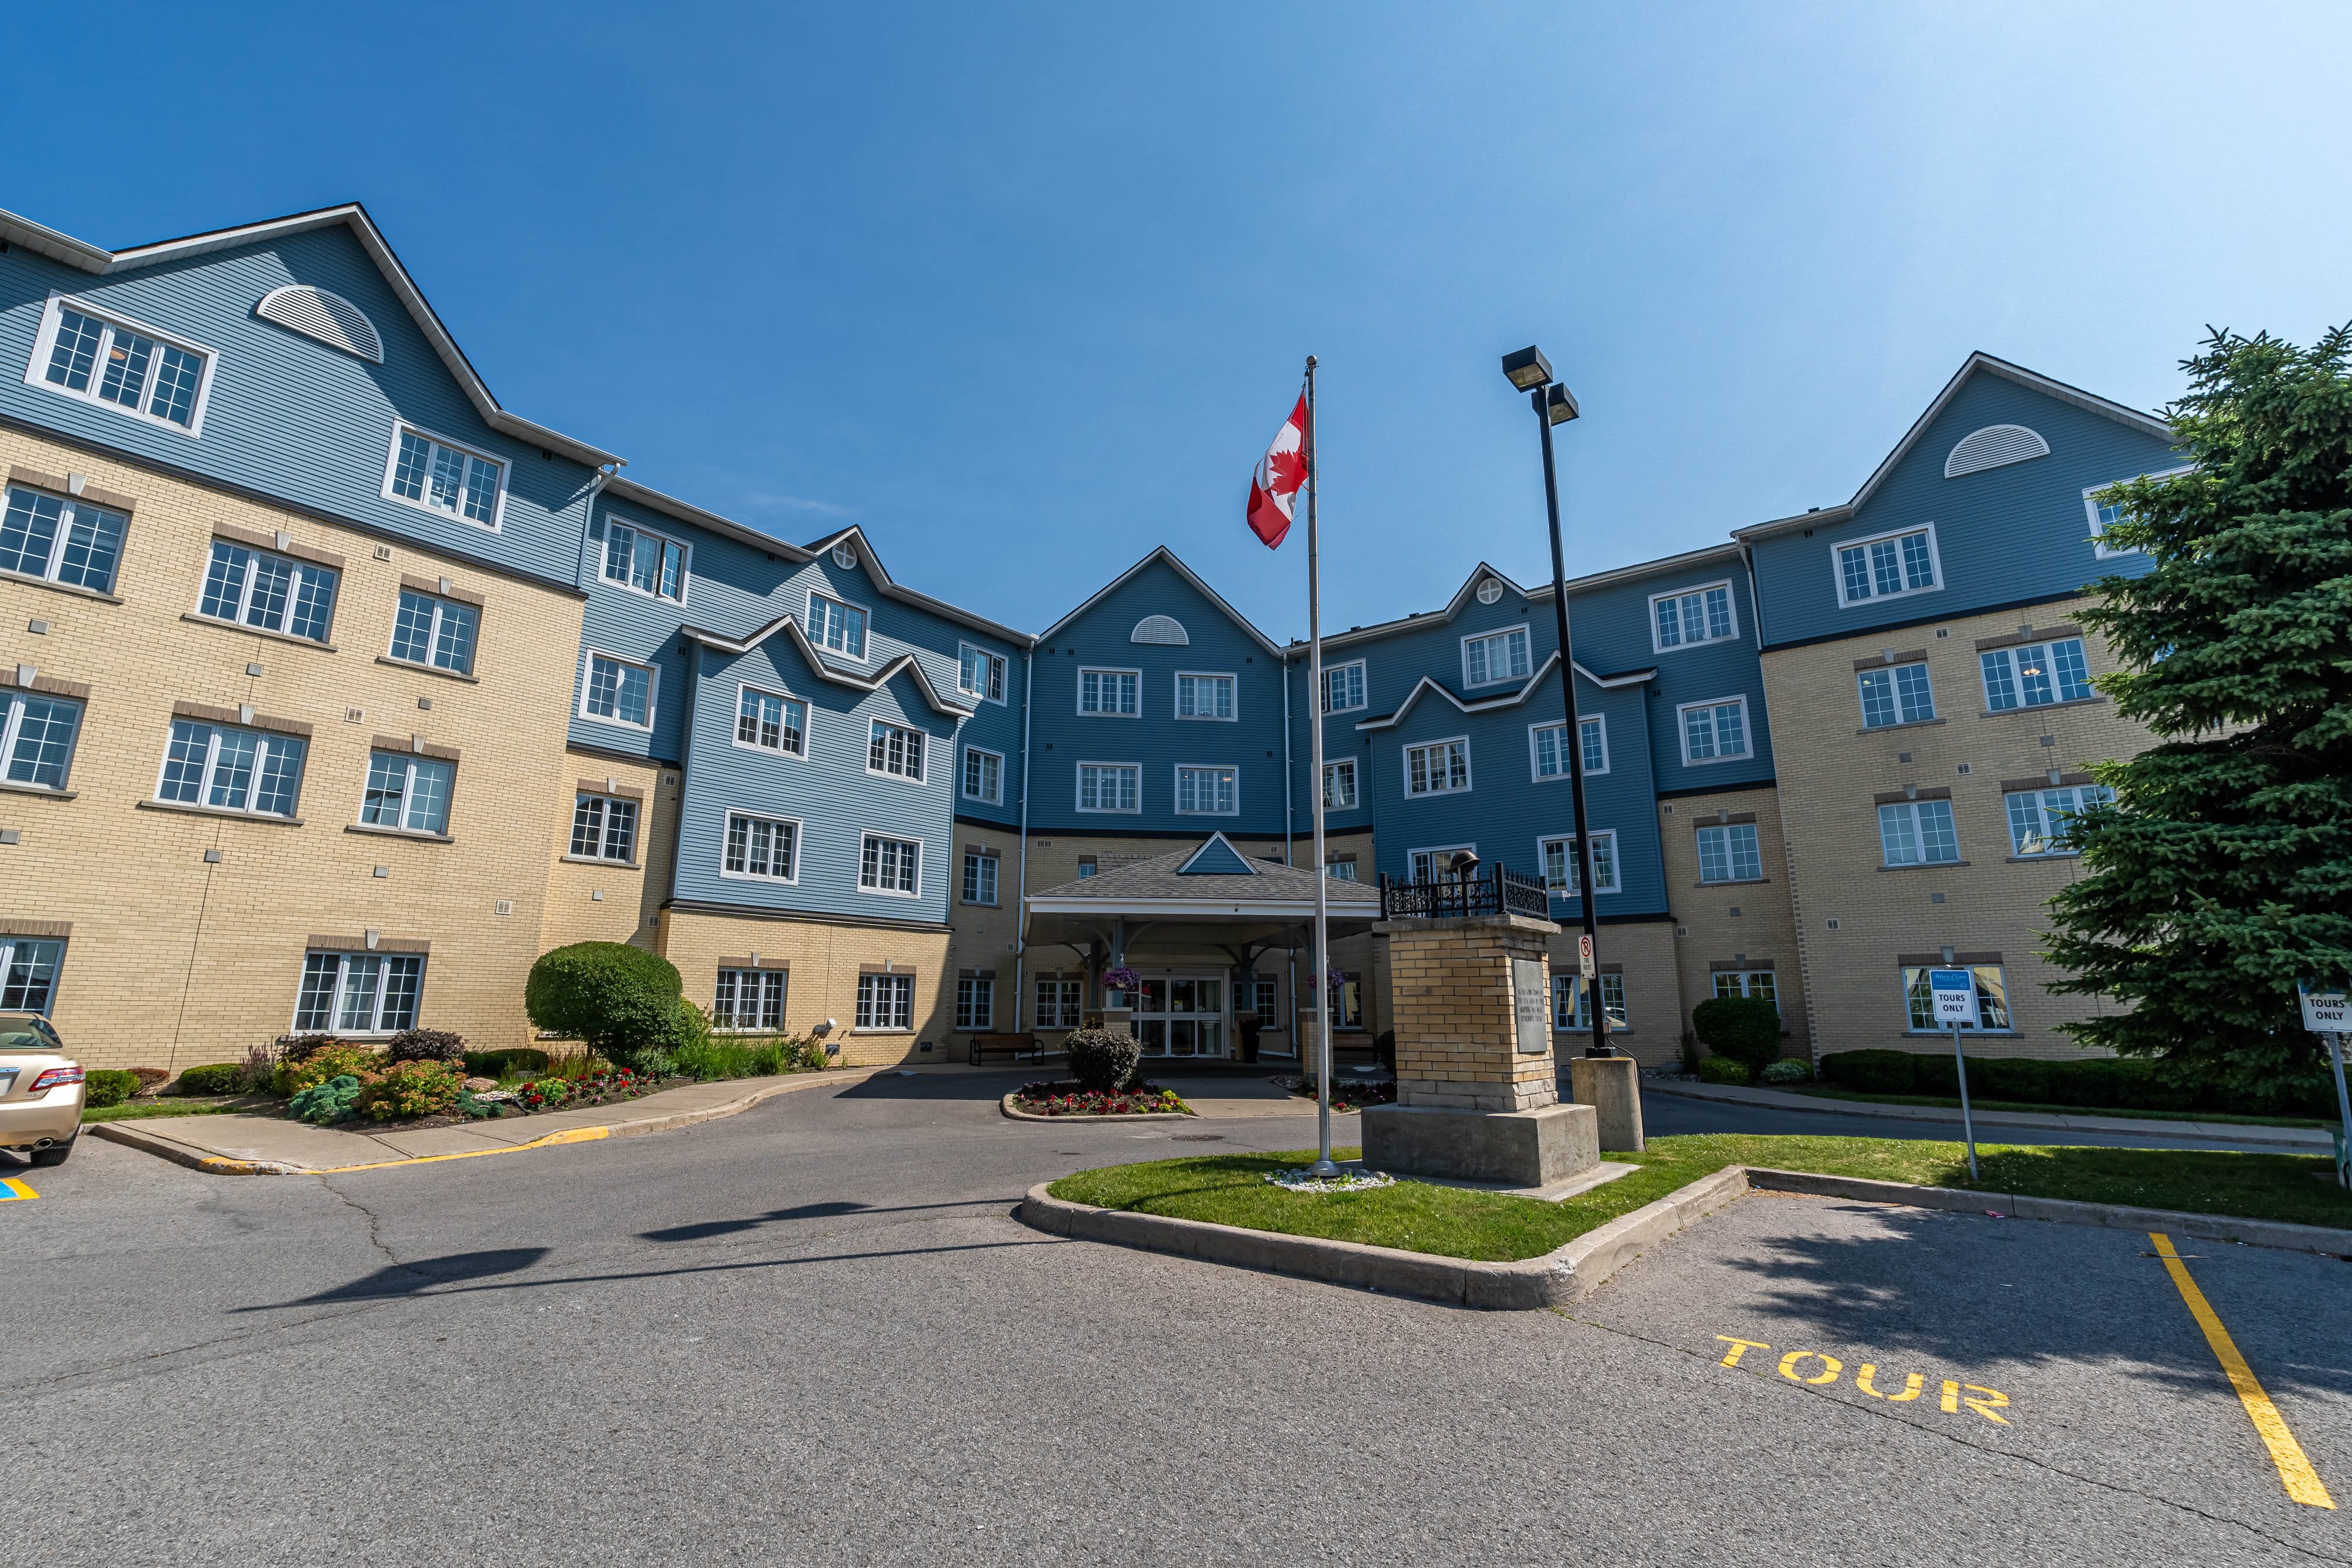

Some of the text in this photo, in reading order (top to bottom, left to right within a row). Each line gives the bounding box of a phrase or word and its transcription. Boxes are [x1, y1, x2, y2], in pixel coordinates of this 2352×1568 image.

[2310, 999, 2345, 1008] TOURS
[2316, 1011, 2343, 1020] ONLY
[1716, 1335, 2012, 1425] TOUR
